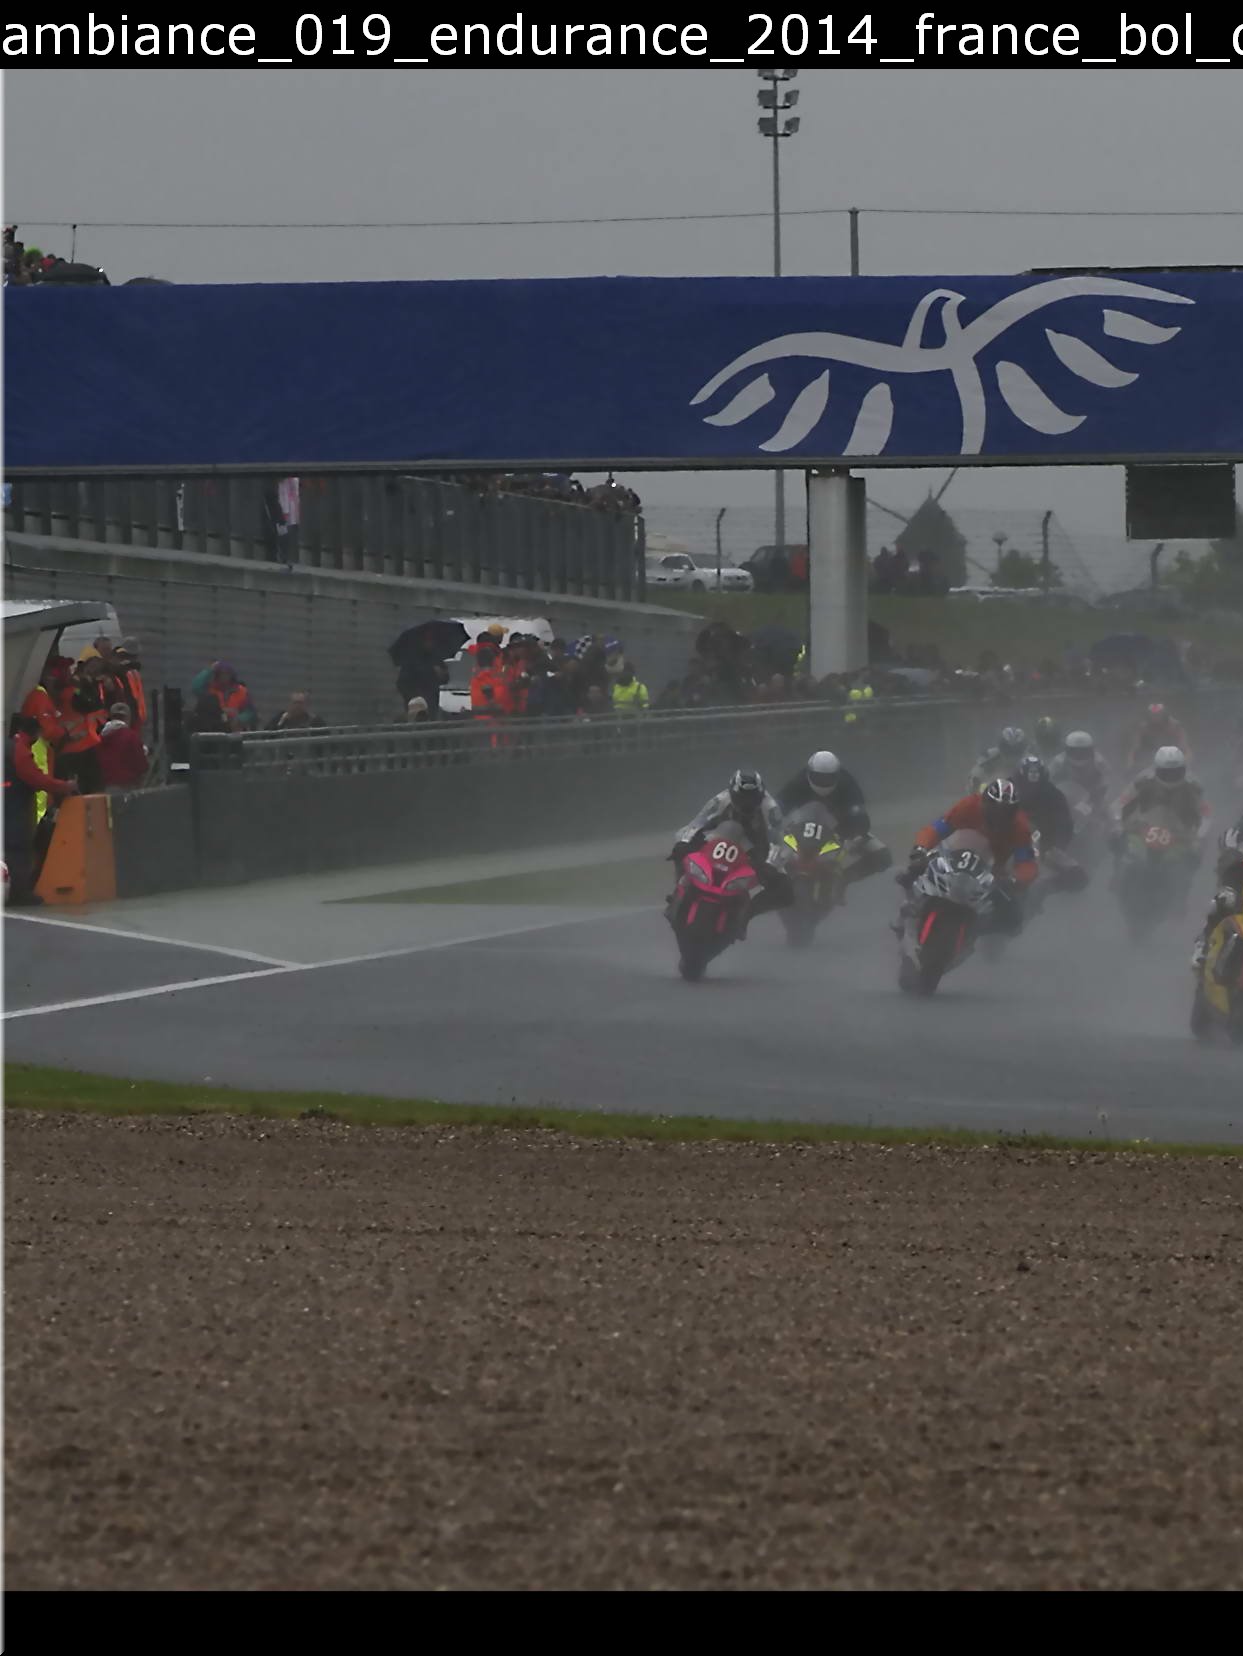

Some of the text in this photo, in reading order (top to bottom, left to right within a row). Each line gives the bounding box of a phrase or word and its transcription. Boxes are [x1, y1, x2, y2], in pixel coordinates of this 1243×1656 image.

[803, 822, 823, 840] 51
[711, 841, 739, 863] 60
[957, 850, 981, 872] 37
